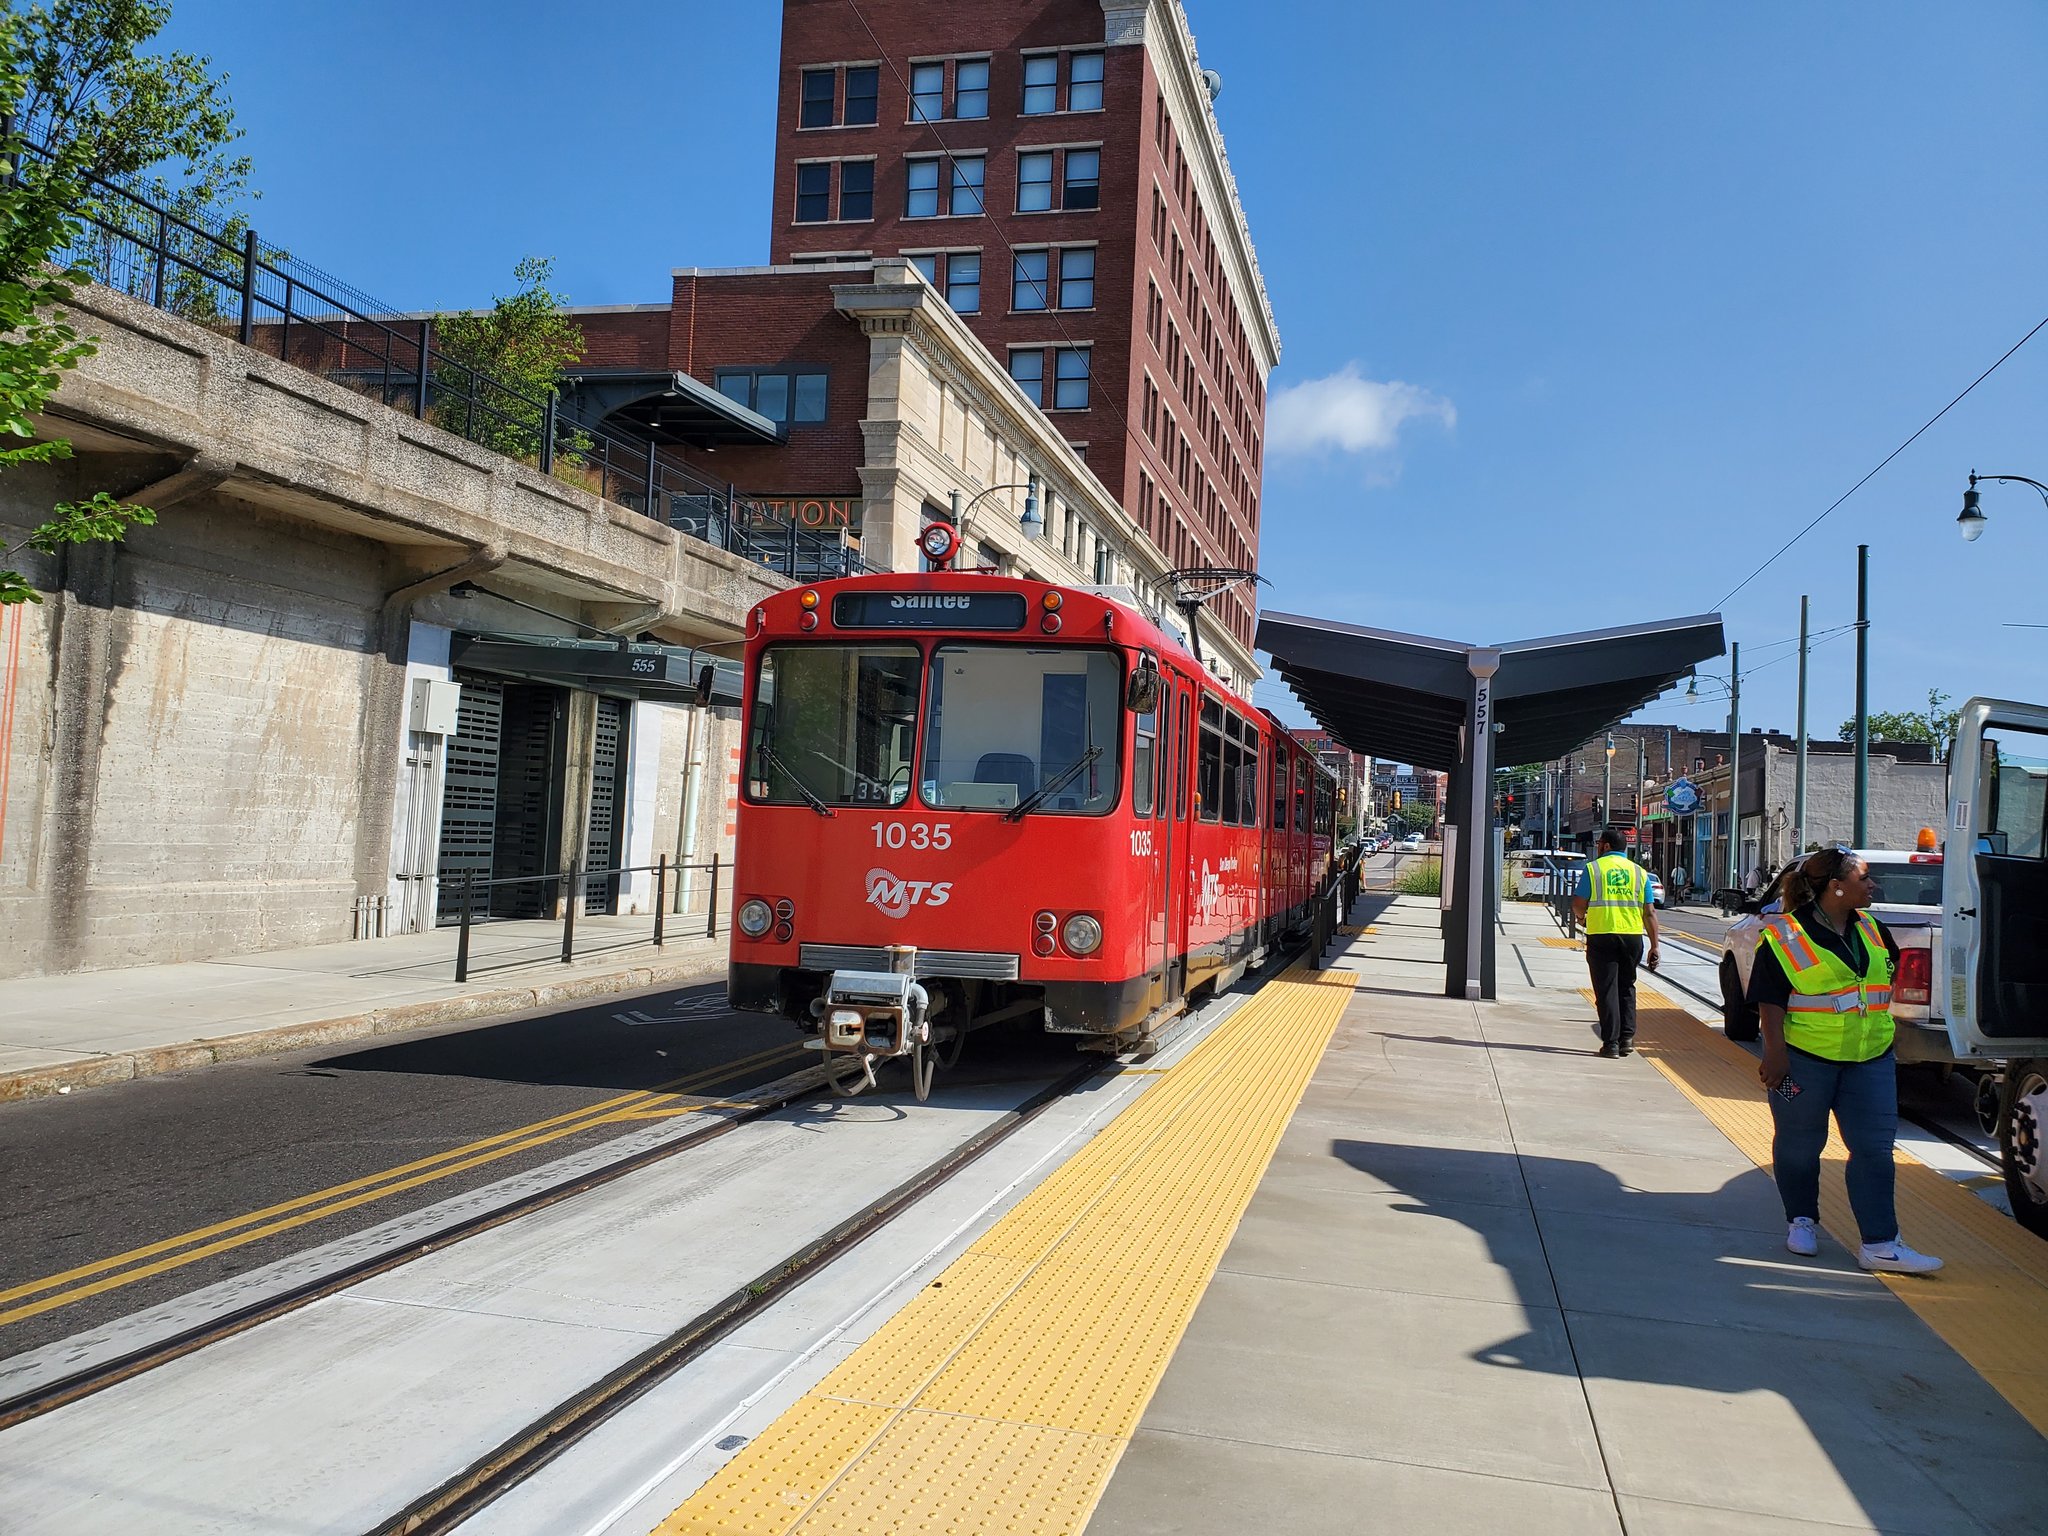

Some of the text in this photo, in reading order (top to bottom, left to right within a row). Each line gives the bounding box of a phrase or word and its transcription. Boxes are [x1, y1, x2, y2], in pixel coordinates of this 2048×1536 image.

[631, 658, 656, 673] 555
[1477, 688, 1487, 735] 557
[871, 822, 952, 850] 1035
[1130, 830, 1152, 856] 1035
[866, 880, 954, 906] MTS
[1607, 888, 1632, 896] MATA
